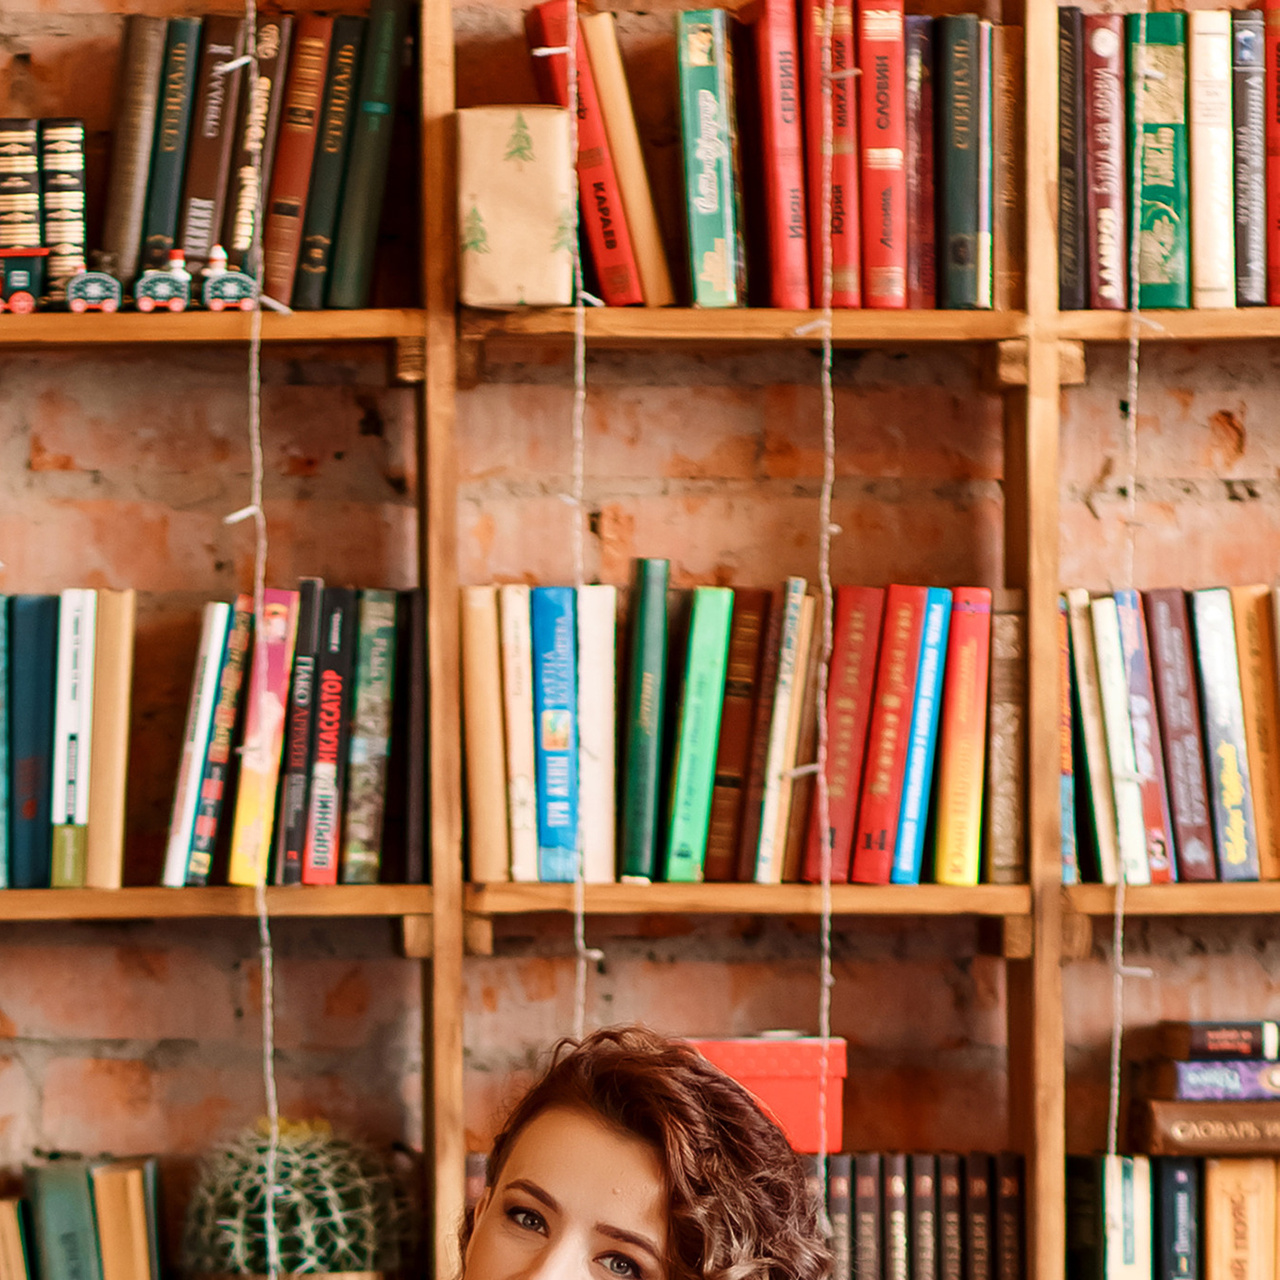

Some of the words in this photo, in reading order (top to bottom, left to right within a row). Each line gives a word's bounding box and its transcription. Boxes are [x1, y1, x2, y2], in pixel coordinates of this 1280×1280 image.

[162, 42, 188, 152] СТЕНДАЛЬ
[202, 61, 226, 138] СТЕНДАЛЬ
[324, 44, 356, 154] СТЕНДАЛЬ
[779, 50, 797, 124] СЕРБИН
[833, 39, 848, 128] МИХАЛИК
[875, 55, 891, 130] СЛОВИН
[952, 40, 971, 149] СТЕНДАЛЬ
[592, 181, 617, 250] КАРАЕВ
[787, 188, 804, 238] Иван
[878, 186, 894, 248] Леонид
[296, 656, 314, 706] ПАКО
[546, 755, 569, 797] ЖЕНЫ
[546, 802, 570, 828] ТРИ
[1170, 1119, 1261, 1142] СЛОВАРЬ
